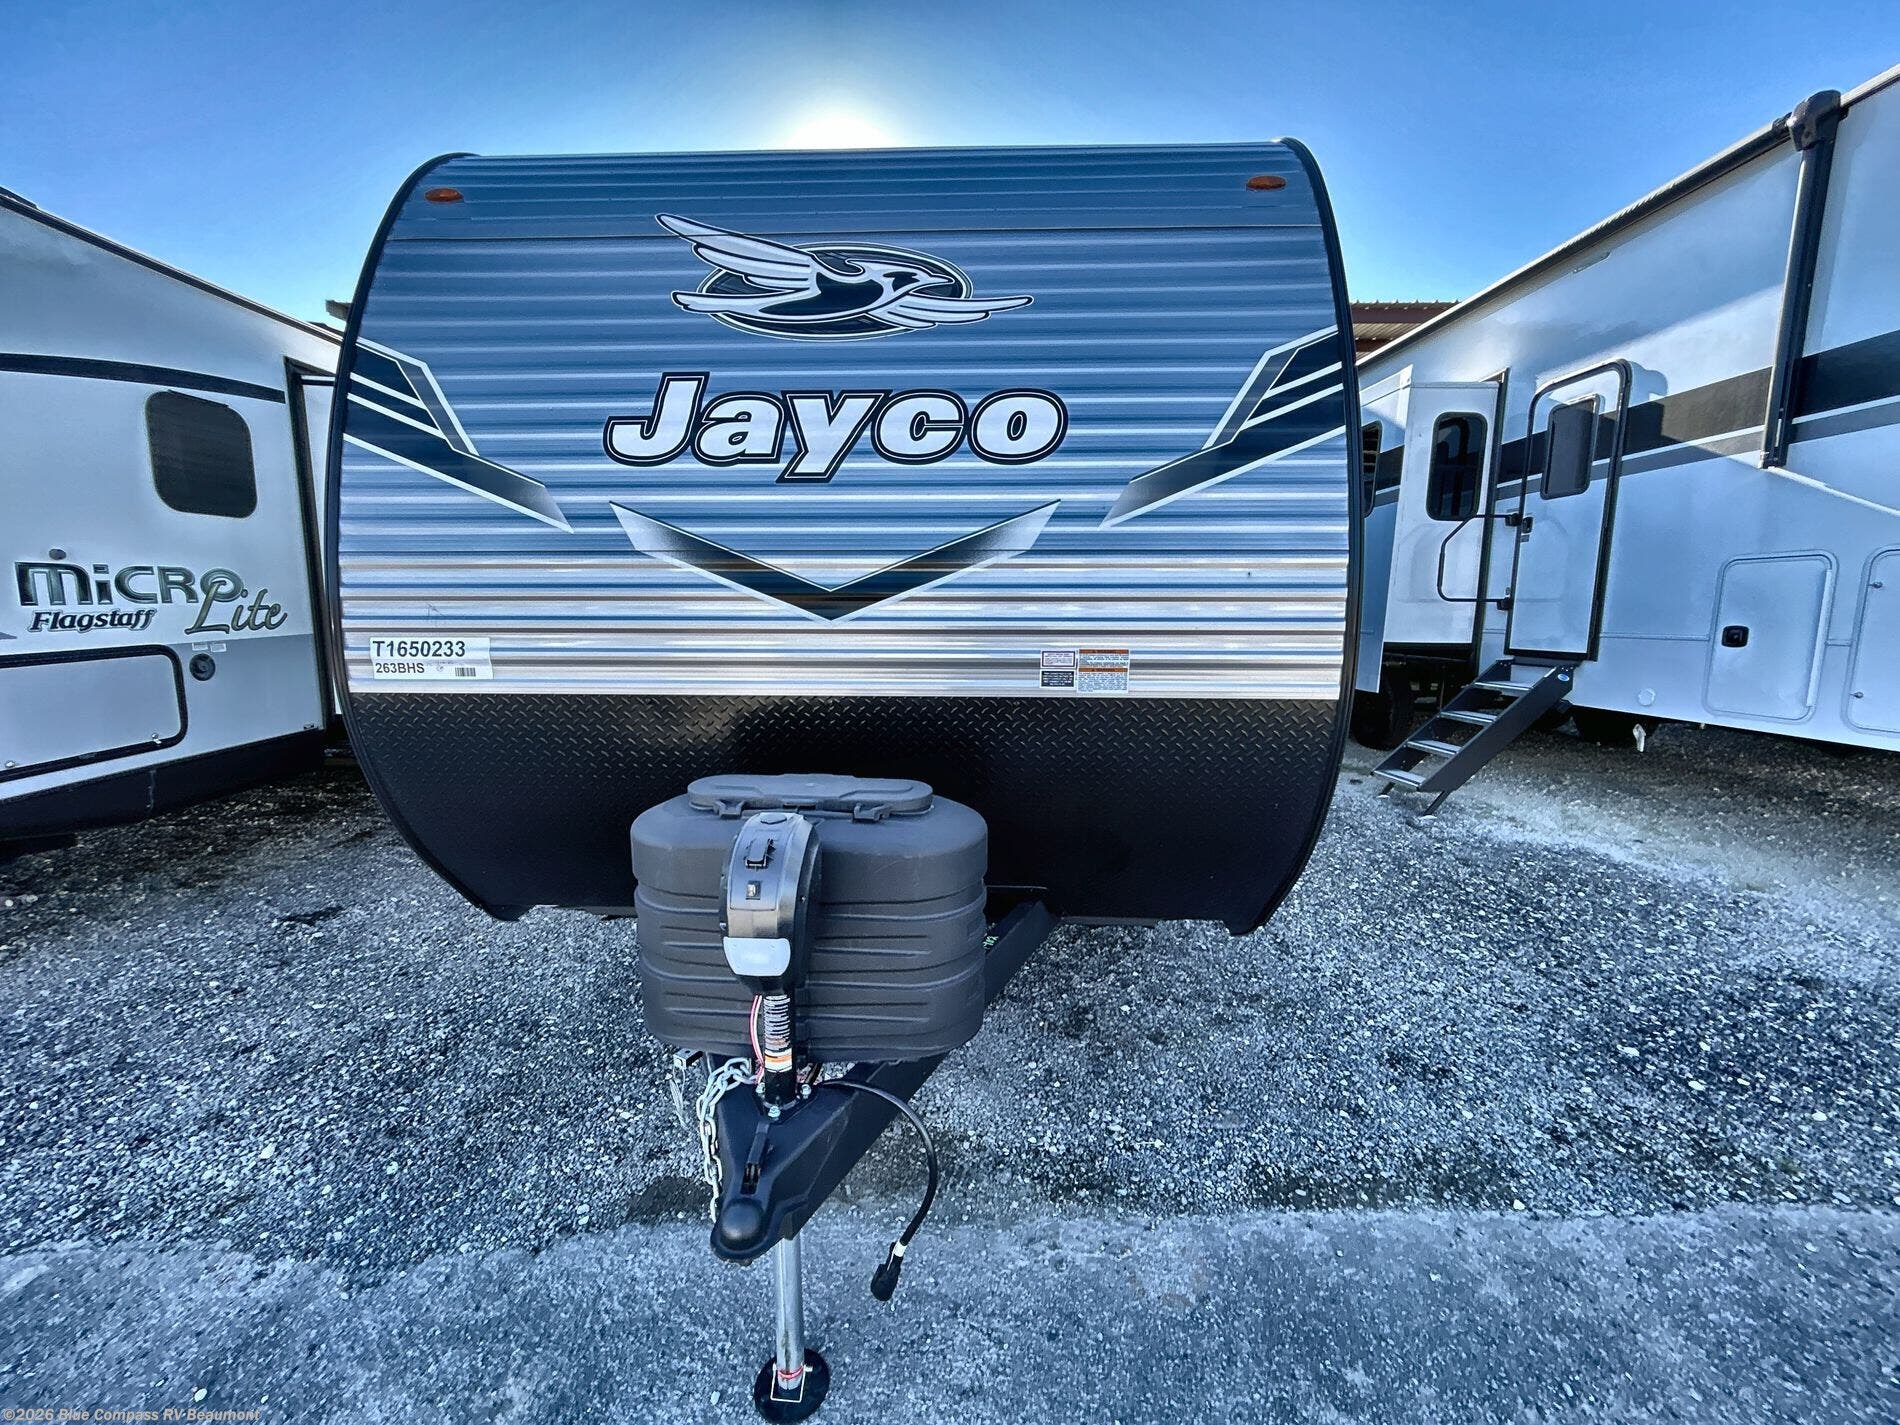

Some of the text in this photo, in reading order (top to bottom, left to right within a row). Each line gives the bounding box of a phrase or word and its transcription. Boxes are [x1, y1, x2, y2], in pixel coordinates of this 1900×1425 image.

[603, 371, 1068, 484] Jayco
[184, 580, 288, 635] Lite
[28, 609, 157, 632] Flagstaff
[372, 640, 466, 658] T1650233
[375, 662, 425, 674] 263BHS
